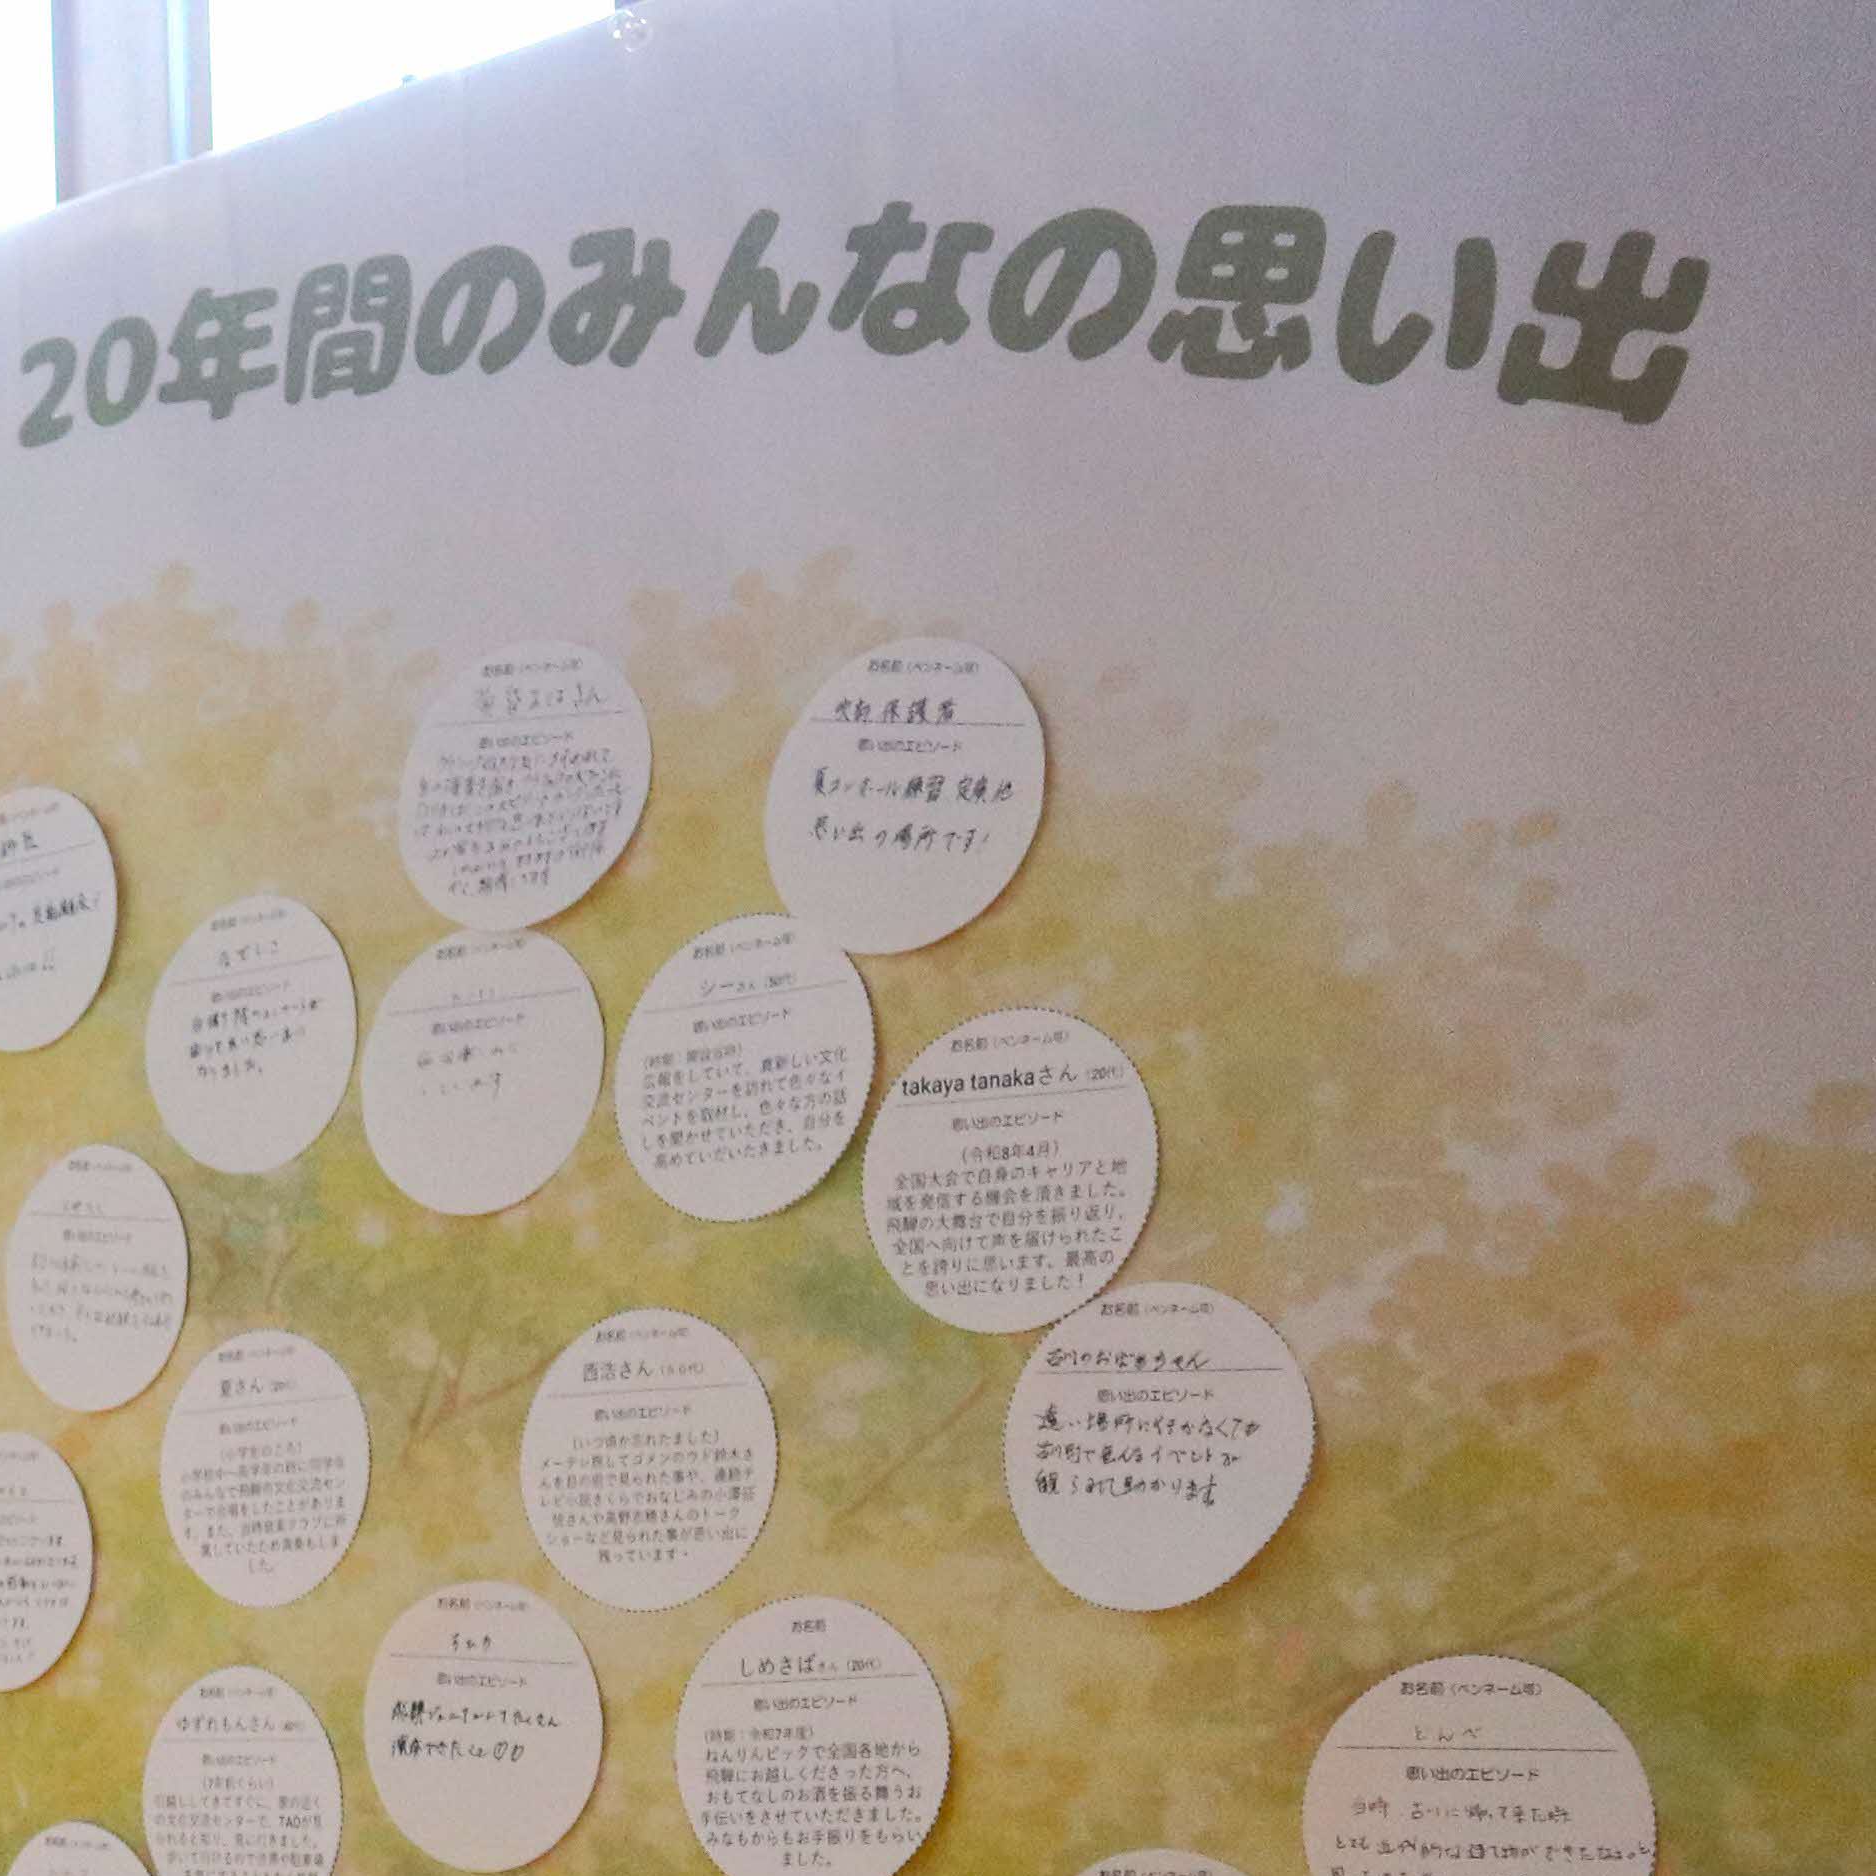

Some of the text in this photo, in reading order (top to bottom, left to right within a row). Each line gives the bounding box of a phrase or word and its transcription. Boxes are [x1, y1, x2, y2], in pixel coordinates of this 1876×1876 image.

[18, 202, 1714, 450] 20年間のみんなの思い出
[902, 1071, 964, 1097] takaya
